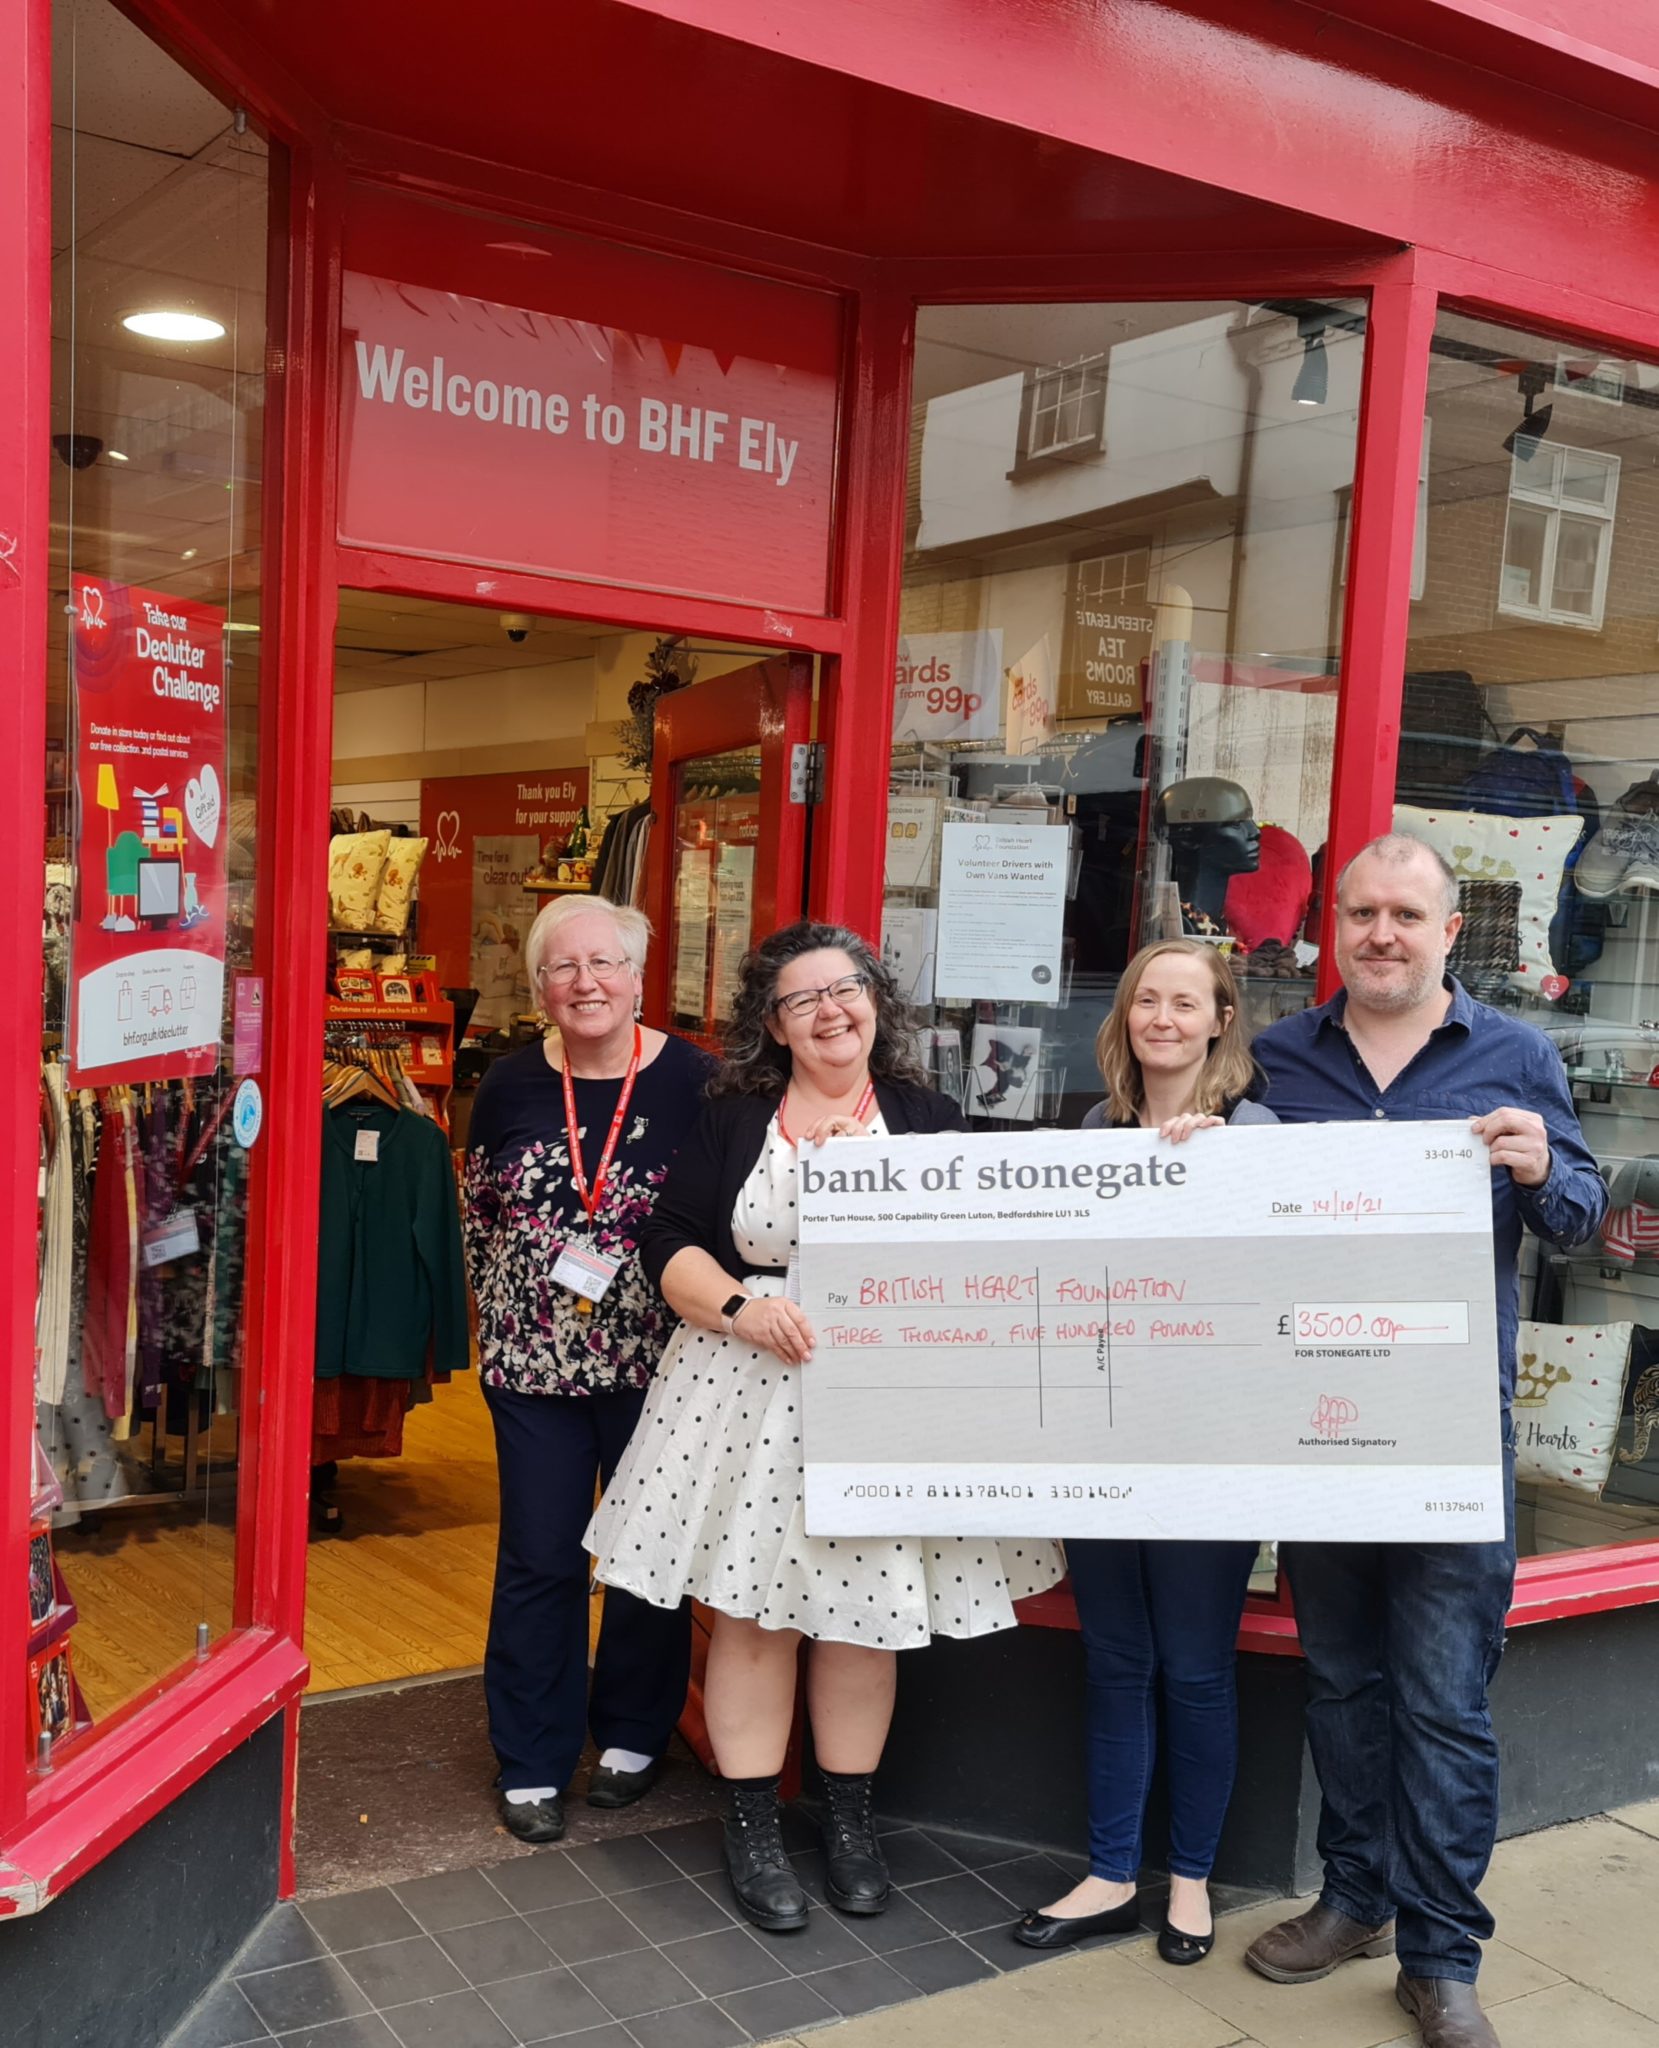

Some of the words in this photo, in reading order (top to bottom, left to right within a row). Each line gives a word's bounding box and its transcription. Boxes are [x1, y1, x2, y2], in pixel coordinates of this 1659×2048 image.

[355, 341, 569, 434] Welcome
[582, 393, 625, 445] to
[639, 397, 728, 463] BHF
[739, 417, 799, 487] Ely
[143, 602, 169, 628] Take
[170, 615, 187, 631] our
[136, 627, 205, 668] Declutter
[895, 656, 951, 685] ards
[153, 665, 220, 713] Challenge
[900, 688, 925, 700] from
[926, 686, 982, 721] 99p
[90, 722, 111, 736] Donate
[112, 726, 118, 736] in
[177, 733, 191, 744] about
[113, 742, 140, 754] collection
[169, 747, 189, 759] services
[517, 783, 543, 800] Thank
[545, 786, 560, 803] you
[563, 782, 576, 803] Ely
[516, 808, 527, 824] for
[529, 811, 549, 828] your
[958, 859, 1000, 868] Volunteer
[1002, 860, 1032, 868] Drivers
[1034, 861, 1054, 869] with
[483, 866, 508, 885] clear
[966, 871, 985, 880] Own
[988, 872, 1008, 880] Vans
[1010, 872, 1044, 881] Wanted
[1425, 1149, 1473, 1160] 33-01-40
[800, 1157, 907, 1194] bank
[921, 1155, 964, 1191] of
[978, 1155, 1187, 1199] stonegate
[803, 1214, 828, 1223] Porter
[830, 1214, 846, 1222] Tun
[847, 1213, 876, 1222] House,
[878, 1213, 893, 1221] 500
[895, 1212, 938, 1222] Capability
[940, 1212, 966, 1220] Green
[968, 1212, 996, 1221] Luton,
[997, 1210, 1053, 1219] Bedfordshire
[1056, 1210, 1072, 1218] LU1
[1074, 1209, 1090, 1218] 3LS
[1272, 1202, 1302, 1213] Date
[1313, 1191, 1382, 1221] 14/10/21
[828, 1293, 848, 1306] Pay
[860, 1275, 944, 1305] BRITISH
[965, 1275, 1037, 1303] HEART
[1056, 1278, 1186, 1303] FOUNDATION
[822, 1325, 883, 1346] THREE
[898, 1326, 995, 1346] THOUSAND,
[1009, 1324, 1047, 1343] FIVE
[1056, 1319, 1135, 1340] HUNDRED
[1150, 1319, 1215, 1340] POUNDS
[1277, 1314, 1290, 1335] £
[1097, 1328, 1108, 1350] Payee
[1097, 1351, 1105, 1371] A/C
[1295, 1350, 1314, 1358] FOR
[1316, 1349, 1371, 1358] STONEGATE
[1373, 1349, 1391, 1358] LTD
[1298, 1438, 1349, 1446] Authorised
[1352, 1438, 1397, 1448] Signatory
[1526, 1422, 1581, 1450] Hearts
